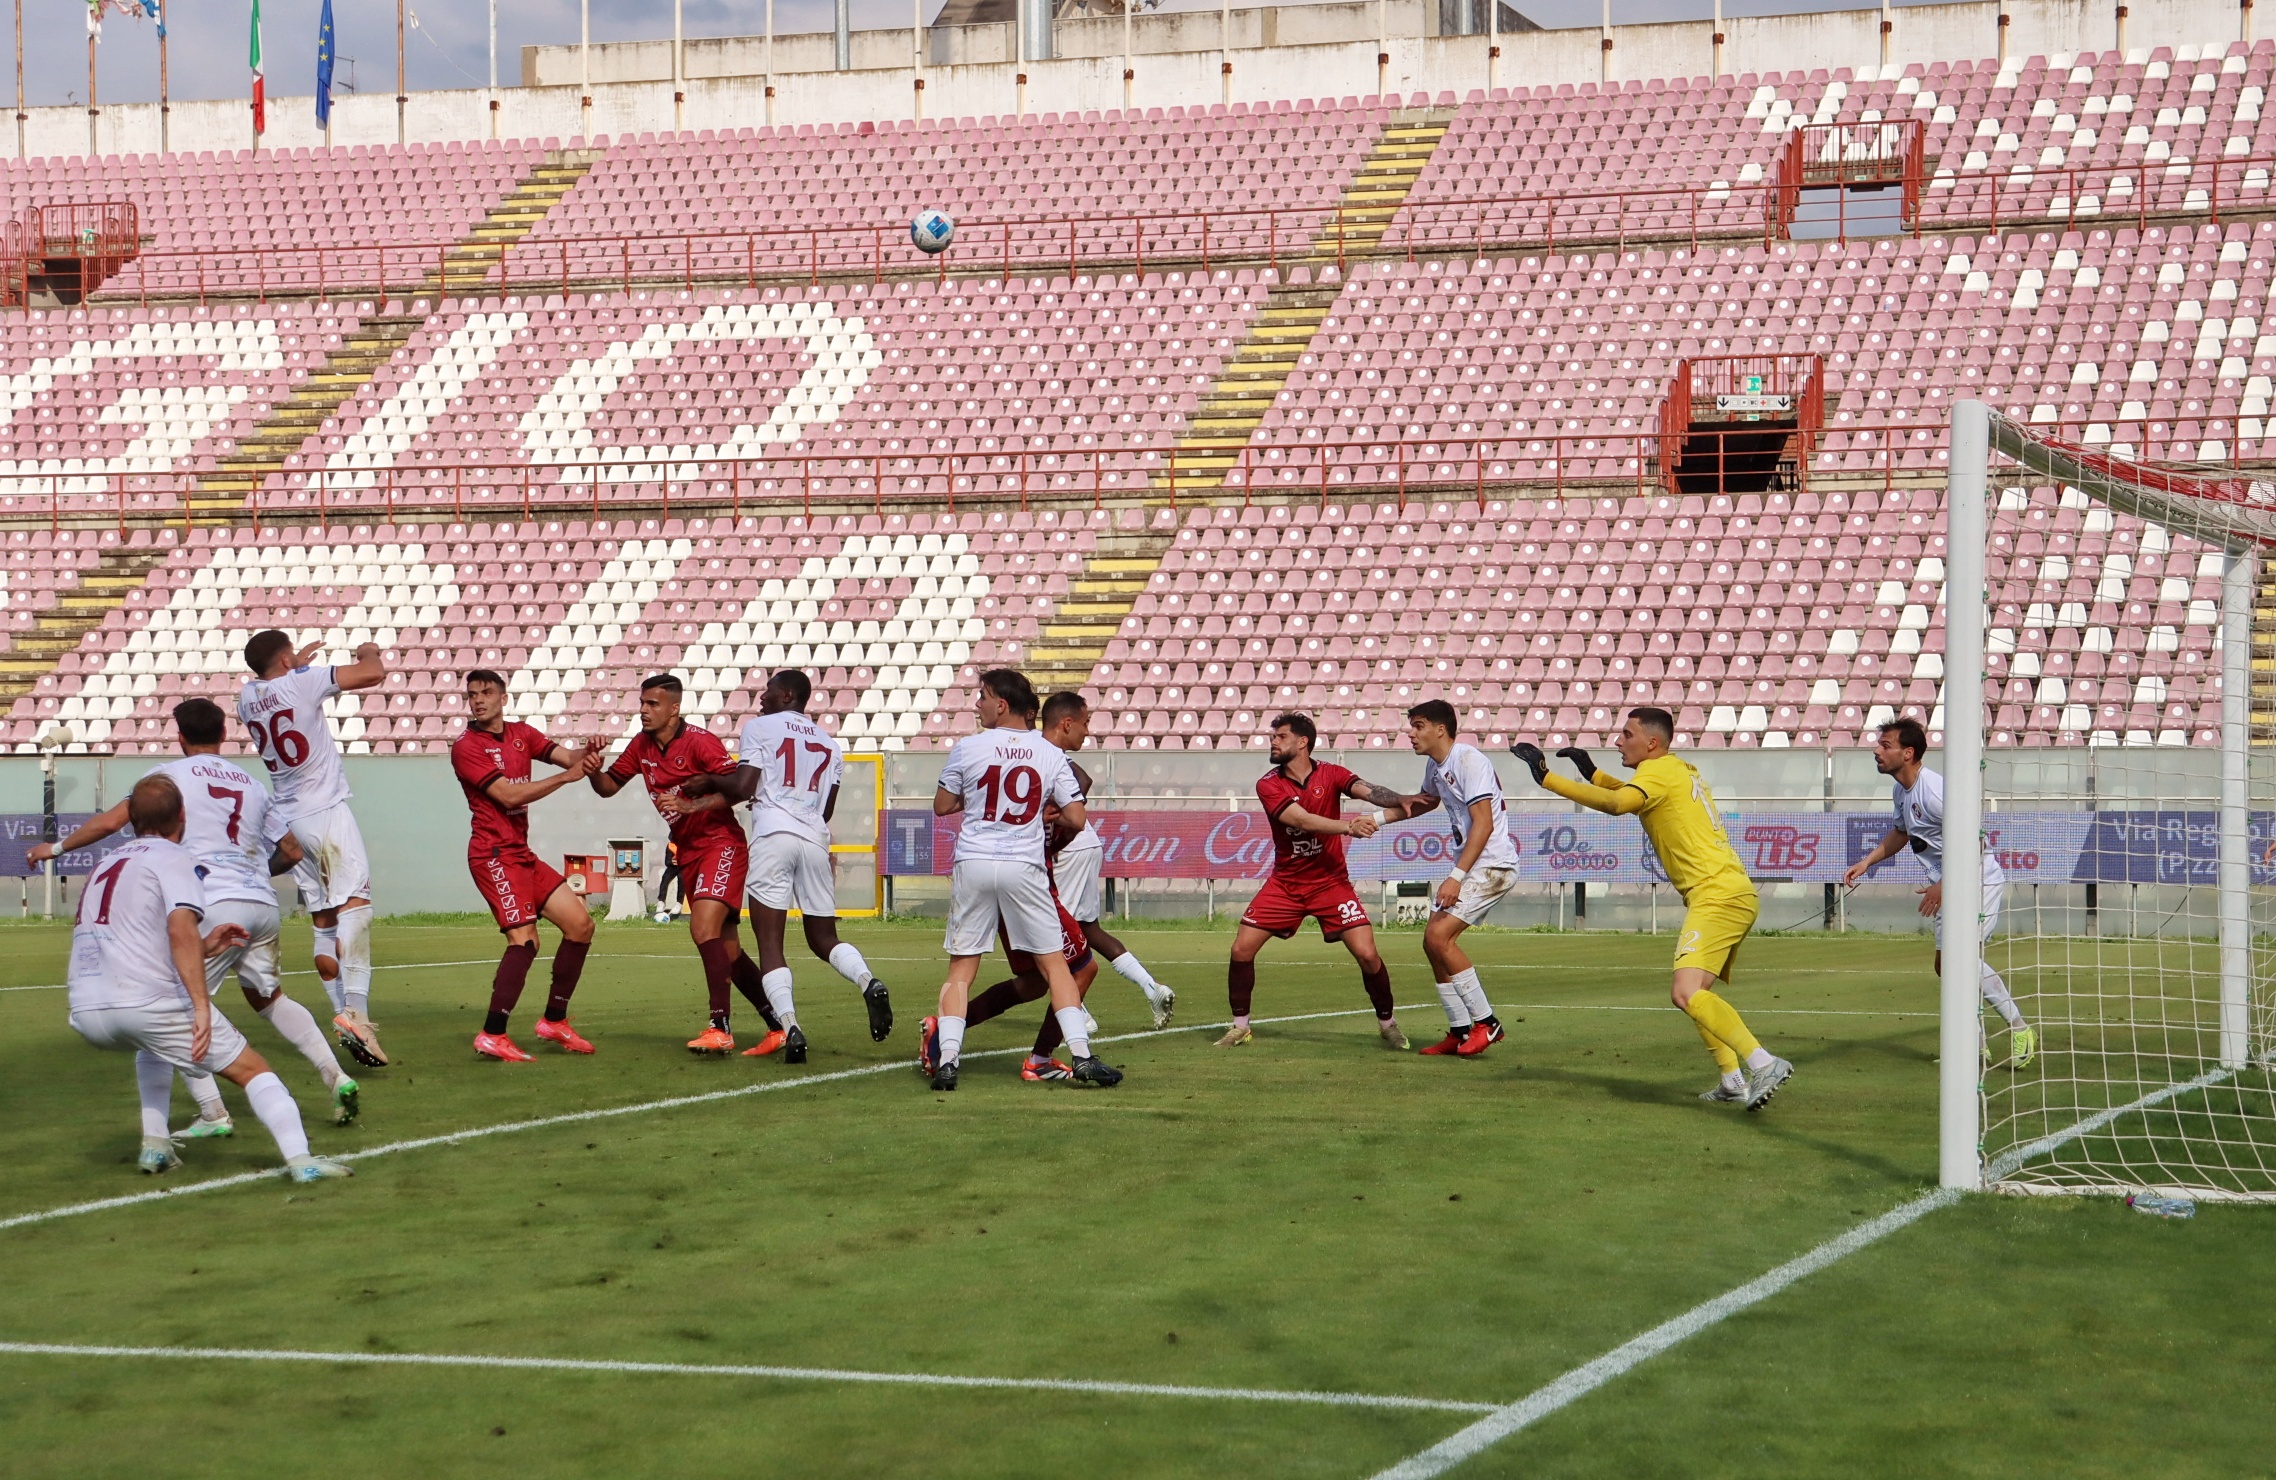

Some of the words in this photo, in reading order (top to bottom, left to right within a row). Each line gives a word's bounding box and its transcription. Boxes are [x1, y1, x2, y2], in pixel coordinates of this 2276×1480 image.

[785, 721, 816, 736] TOURE
[247, 708, 310, 772] 26
[995, 746, 1033, 760] NARDO
[191, 765, 252, 786] GAGLIARDI
[776, 737, 832, 793] 17
[977, 764, 1042, 826] 19
[208, 783, 244, 846] 7
[4, 820, 38, 840] Via
[2112, 817, 2156, 841] Via
[896, 818, 925, 867] T
[1550, 853, 1618, 870] LOTTO
[2157, 850, 2218, 880] (P.zz
[696, 873, 705, 889] 6
[1337, 899, 1361, 919] 32
